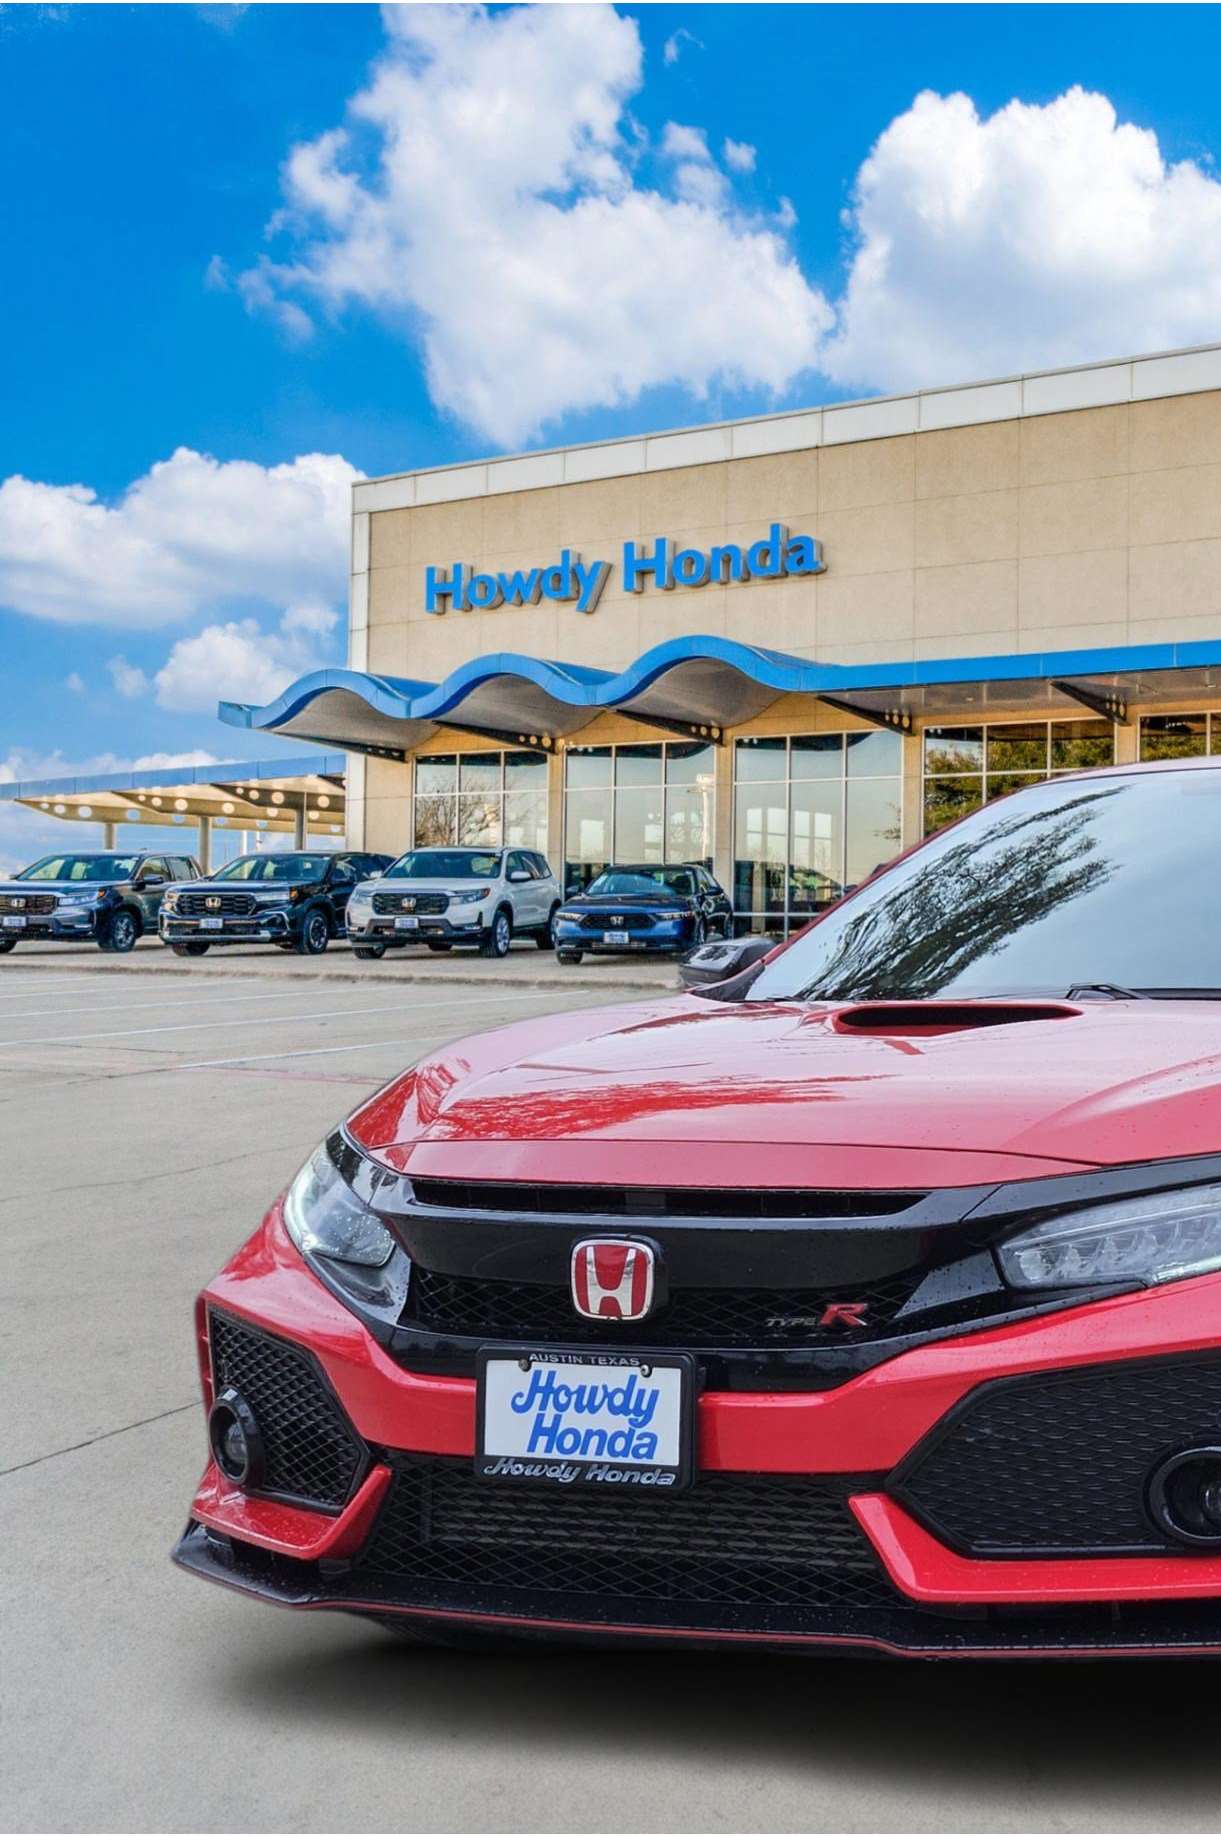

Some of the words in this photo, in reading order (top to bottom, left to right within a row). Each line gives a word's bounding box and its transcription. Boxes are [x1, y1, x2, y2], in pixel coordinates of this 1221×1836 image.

[425, 549, 612, 615] Howdy
[623, 523, 827, 594] Honda
[766, 1317, 817, 1327] TYPE
[820, 1303, 868, 1328] R
[528, 1352, 584, 1365] AUSTIN
[591, 1356, 641, 1367] TEXAS
[511, 1369, 660, 1429] Howdy
[526, 1413, 658, 1460] Honda
[484, 1457, 581, 1484] Howdy
[585, 1463, 676, 1486] Honda
